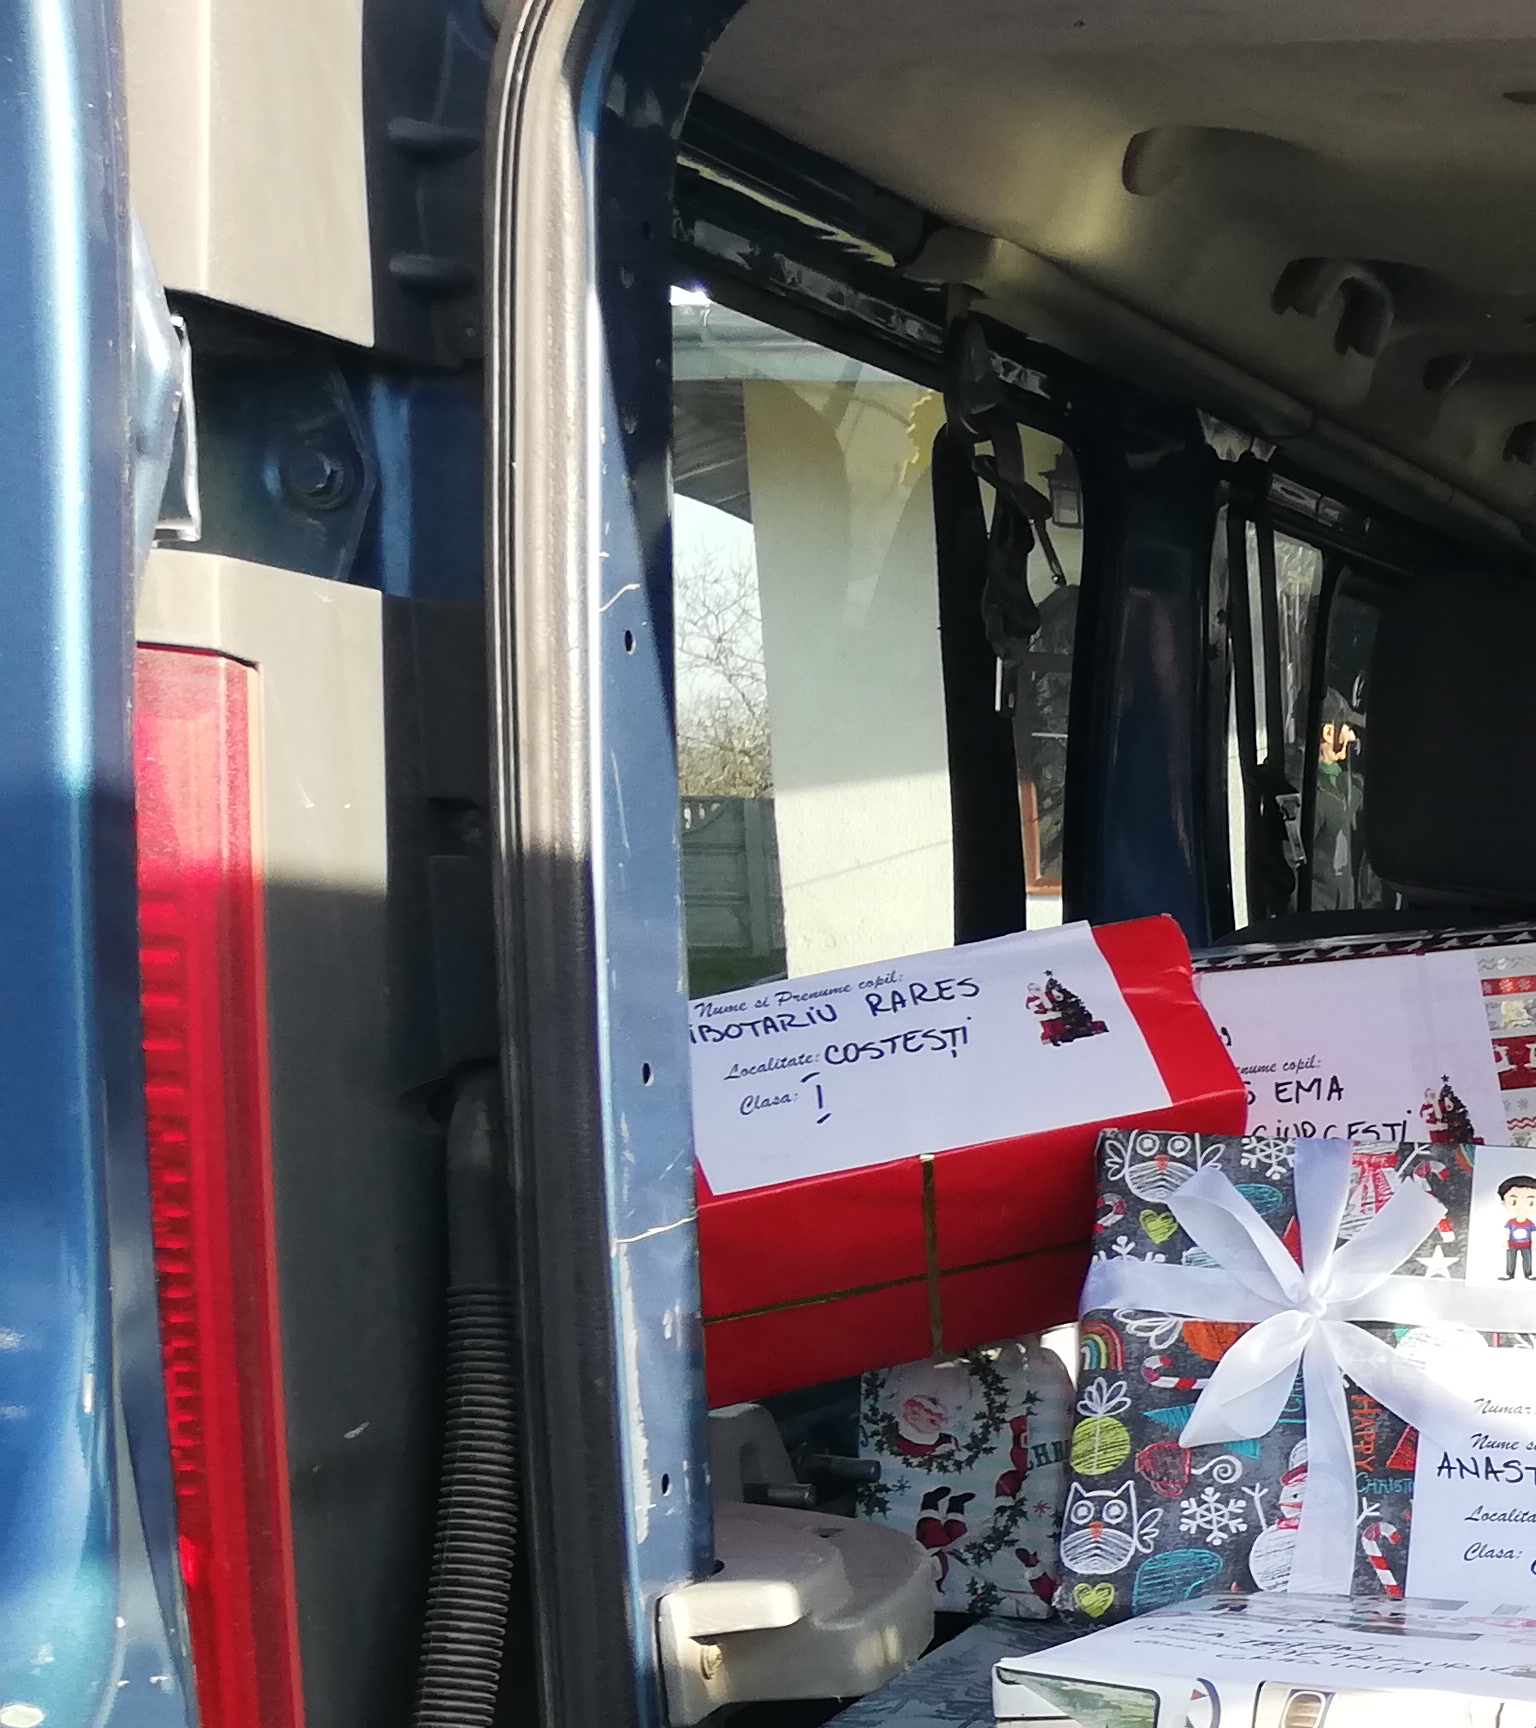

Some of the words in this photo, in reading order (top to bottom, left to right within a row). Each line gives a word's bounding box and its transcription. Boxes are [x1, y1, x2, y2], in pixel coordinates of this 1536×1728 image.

[695, 996, 748, 1018] Nume
[755, 995, 771, 1009] si
[776, 980, 853, 1010] Prenume
[859, 970, 903, 994] copil:
[865, 976, 982, 1018] RARES
[724, 1048, 821, 1081] Localitate:
[1283, 1054, 1323, 1076] copil:
[740, 1089, 799, 1116] Clasa:
[1274, 1075, 1344, 1104] EMA
[1350, 1394, 1384, 1473] HAPPY
[1471, 1433, 1519, 1451] Nume
[1463, 1541, 1523, 1562] Clasa:
